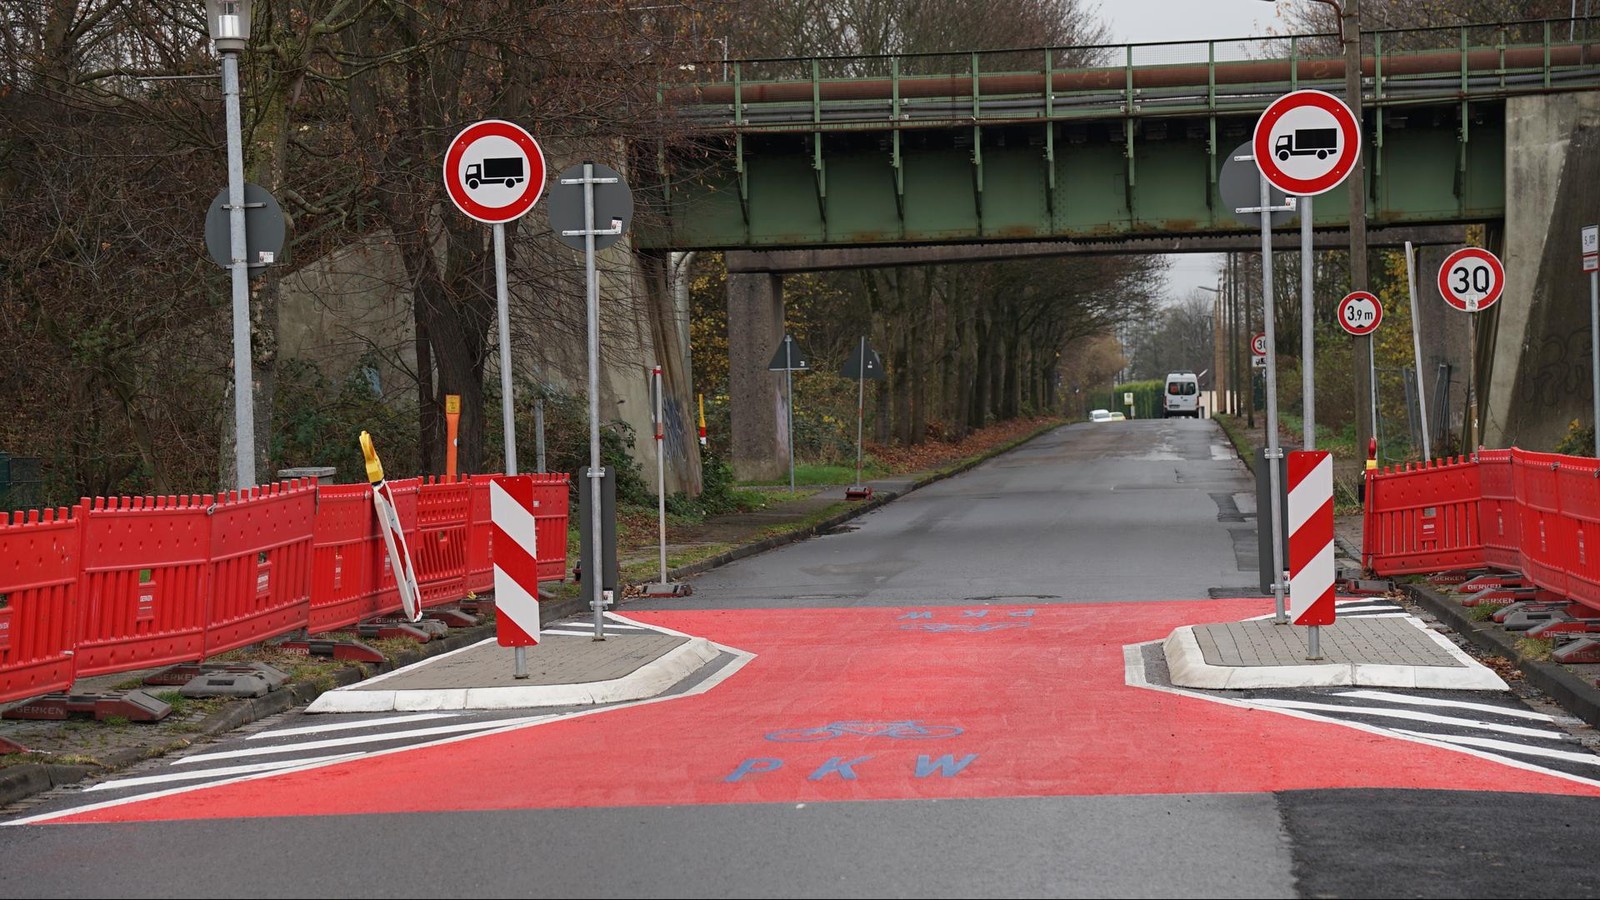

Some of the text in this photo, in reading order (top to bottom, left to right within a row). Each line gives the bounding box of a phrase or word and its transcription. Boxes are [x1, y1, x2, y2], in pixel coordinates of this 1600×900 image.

[1364, 311, 1373, 320] m
[1256, 339, 1266, 350] 3
[15, 705, 64, 715] GERKEN
